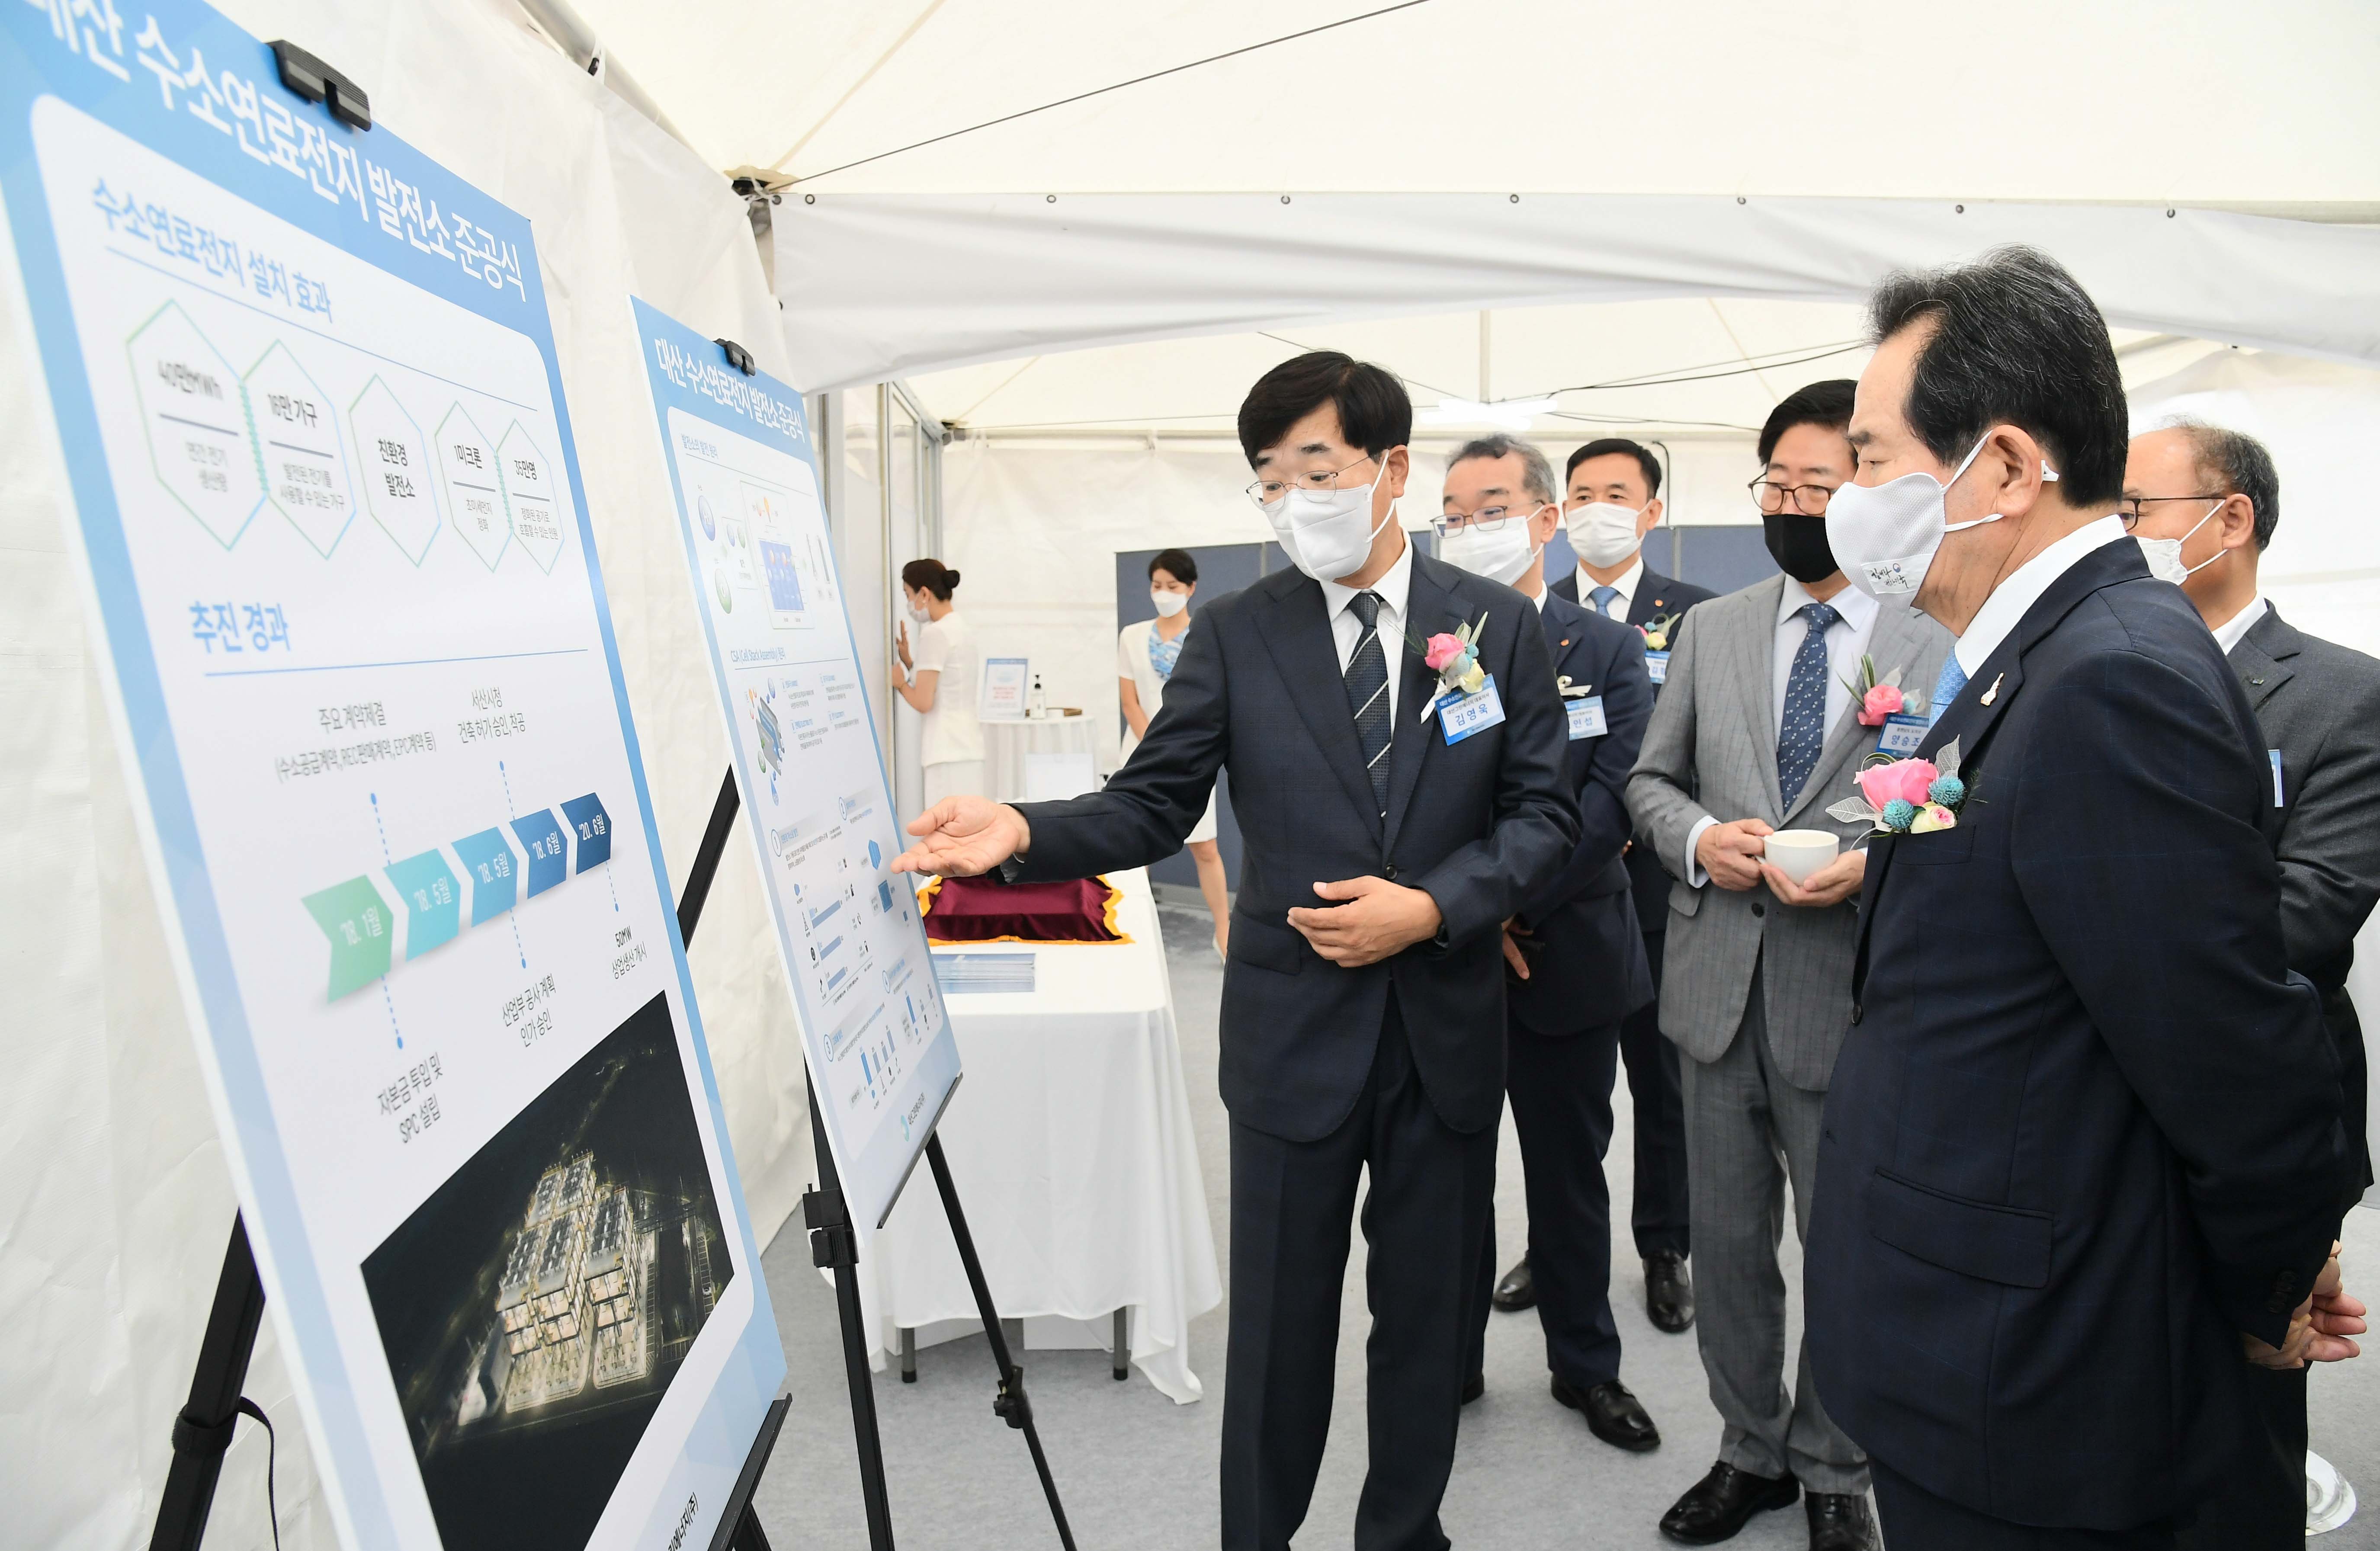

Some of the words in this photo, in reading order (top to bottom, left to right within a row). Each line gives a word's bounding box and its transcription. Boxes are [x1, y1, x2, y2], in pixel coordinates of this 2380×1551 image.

[135, 14, 369, 221] 수소연료전지
[366, 160, 455, 261] 발전소
[452, 213, 526, 302] 준공식
[92, 177, 245, 288] 수소연료전지
[248, 251, 291, 307] 설치
[292, 272, 332, 324] 효과
[654, 338, 686, 388] 대산
[686, 353, 753, 419] 수소연료전지
[749, 387, 781, 428] 발전소
[777, 402, 805, 443] 준공식
[293, 400, 317, 427] 가구
[378, 439, 407, 466] 친환경
[454, 445, 482, 469] 1미크론
[514, 460, 537, 480] 35만명
[385, 473, 415, 498] 발전소
[477, 518, 489, 532] 정화
[189, 602, 242, 653] 추진
[242, 602, 290, 652] 경과
[472, 687, 502, 711] 서산시청
[319, 708, 343, 733] 주요
[343, 702, 386, 729] 계약체결
[458, 721, 476, 743] 건축
[475, 718, 493, 740] 허가
[510, 713, 525, 732] 착공
[593, 814, 606, 835] 6월
[547, 832, 561, 854] 6월
[494, 852, 510, 877] 5월
[433, 877, 451, 904] 5월
[615, 926, 632, 947] 50MW
[613, 949, 635, 979] 상업생산
[634, 941, 647, 961] 개시
[503, 994, 525, 1027] 산업부
[525, 984, 541, 1010] 공사
[540, 974, 555, 997] 계획
[521, 1019, 537, 1048] 인가
[537, 1008, 552, 1035] 승인
[377, 1076, 411, 1114] 자본금
[410, 1061, 431, 1093] 투입
[430, 1053, 443, 1080] 및
[400, 1113, 420, 1143] SPC
[420, 1094, 440, 1128] 설립
